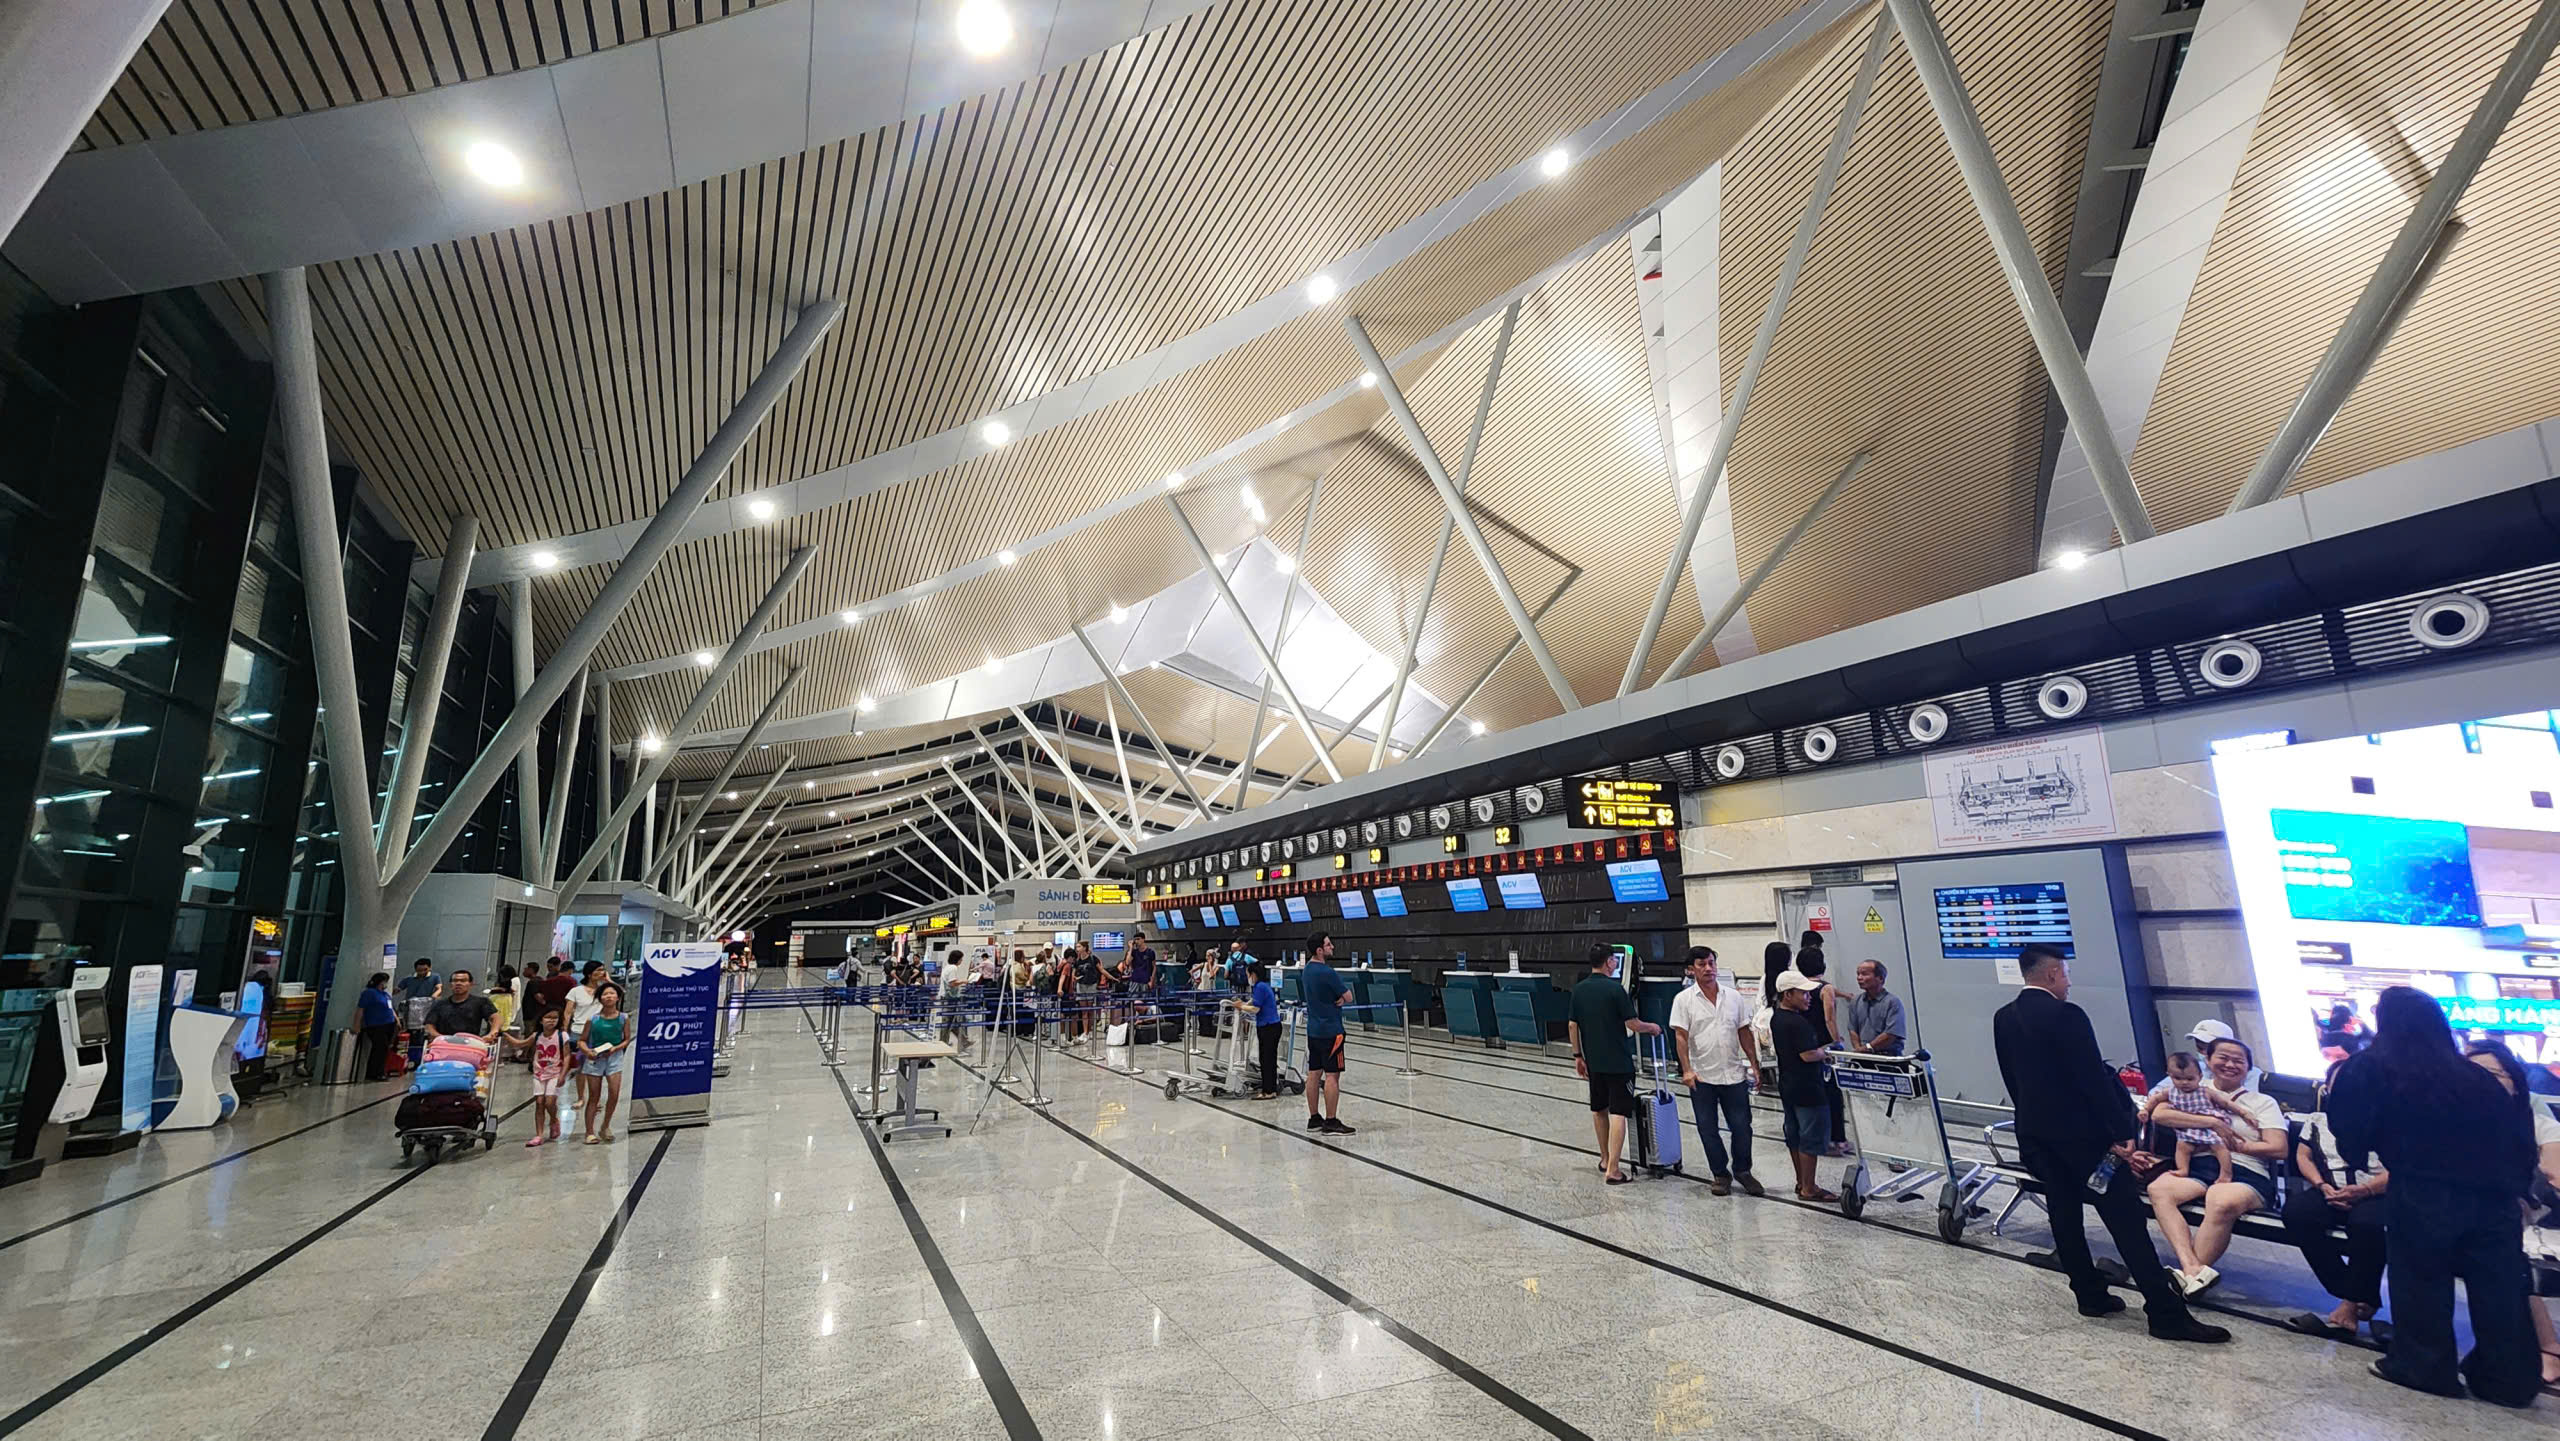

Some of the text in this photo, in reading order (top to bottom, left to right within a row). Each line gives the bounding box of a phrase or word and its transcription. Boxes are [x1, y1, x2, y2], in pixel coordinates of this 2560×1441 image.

[1656, 808, 1674, 826] S2
[1495, 827, 1510, 844] 32
[1445, 836, 1457, 852] 31
[1502, 880, 1517, 889] ACV
[1039, 888, 1070, 901] SẢNH
[1038, 911, 1090, 919] DOMESTIC
[650, 948, 682, 959] ACV
[647, 1021, 680, 1041] 40
[682, 1021, 704, 1030] PHÚT
[684, 1041, 700, 1052] 15
